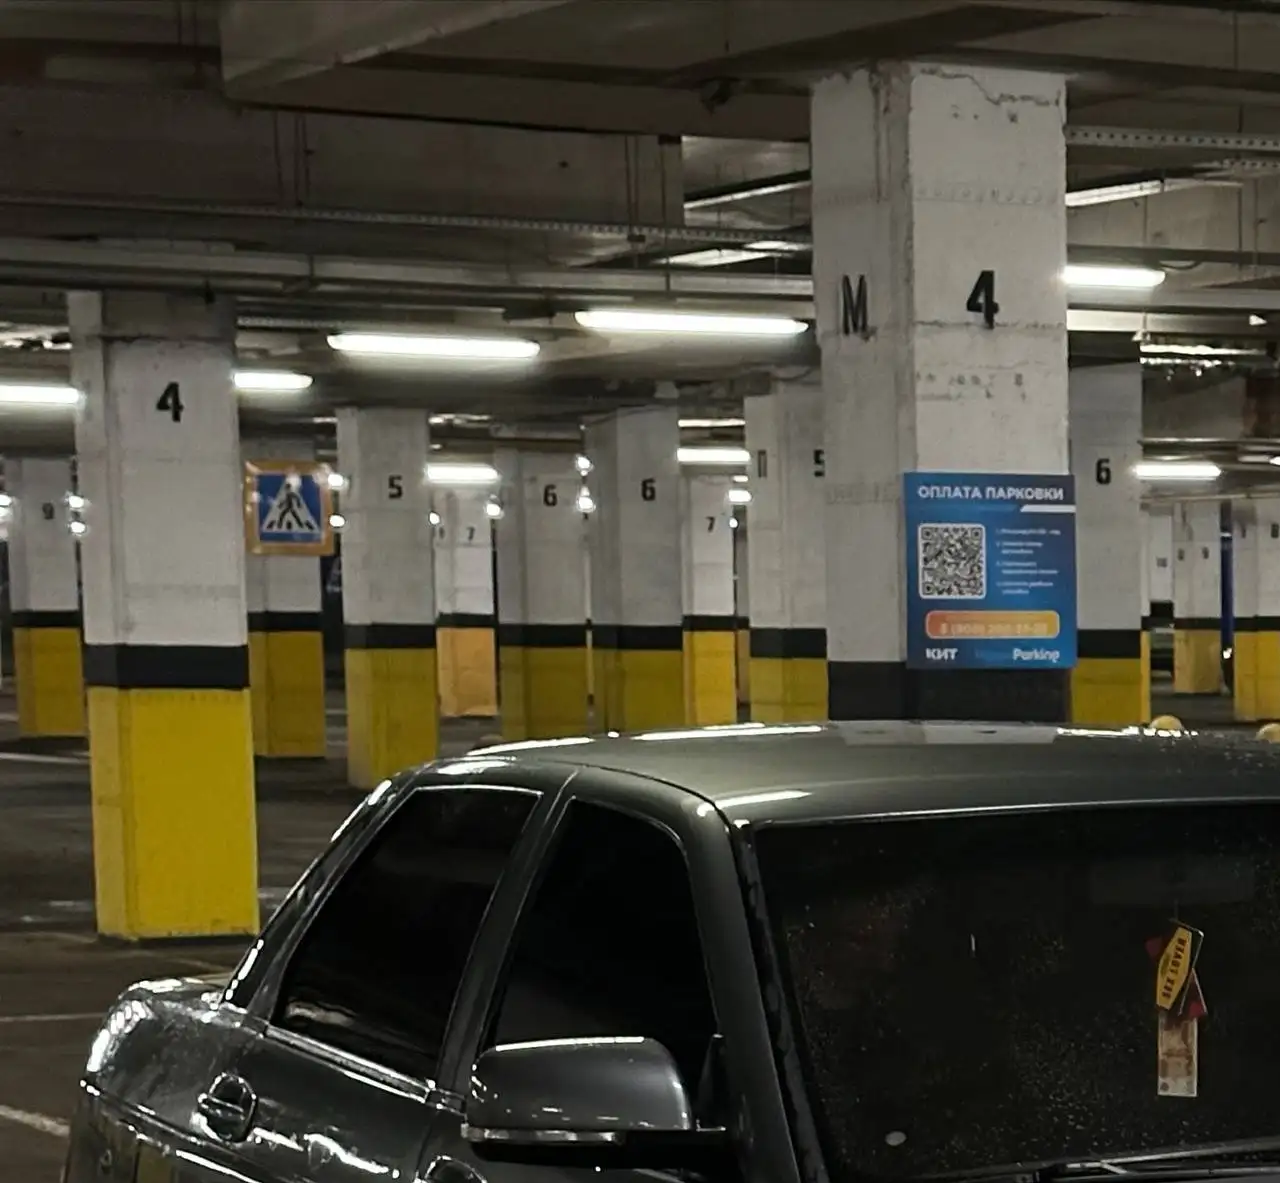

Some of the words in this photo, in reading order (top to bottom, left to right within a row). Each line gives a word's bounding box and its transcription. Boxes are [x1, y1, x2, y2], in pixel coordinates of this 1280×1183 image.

[966, 270, 999, 330] 4
[156, 382, 183, 422] 4
[1096, 459, 1111, 485] 6
[388, 475, 403, 498] 5
[543, 485, 557, 507] 6
[641, 478, 656, 501] 6
[918, 486, 982, 499] ОПЛАТА
[986, 487, 1064, 500] ПАРКОВКИ
[706, 517, 716, 532] 7
[925, 648, 958, 660] КИТ
[1012, 648, 1060, 663] Parking
